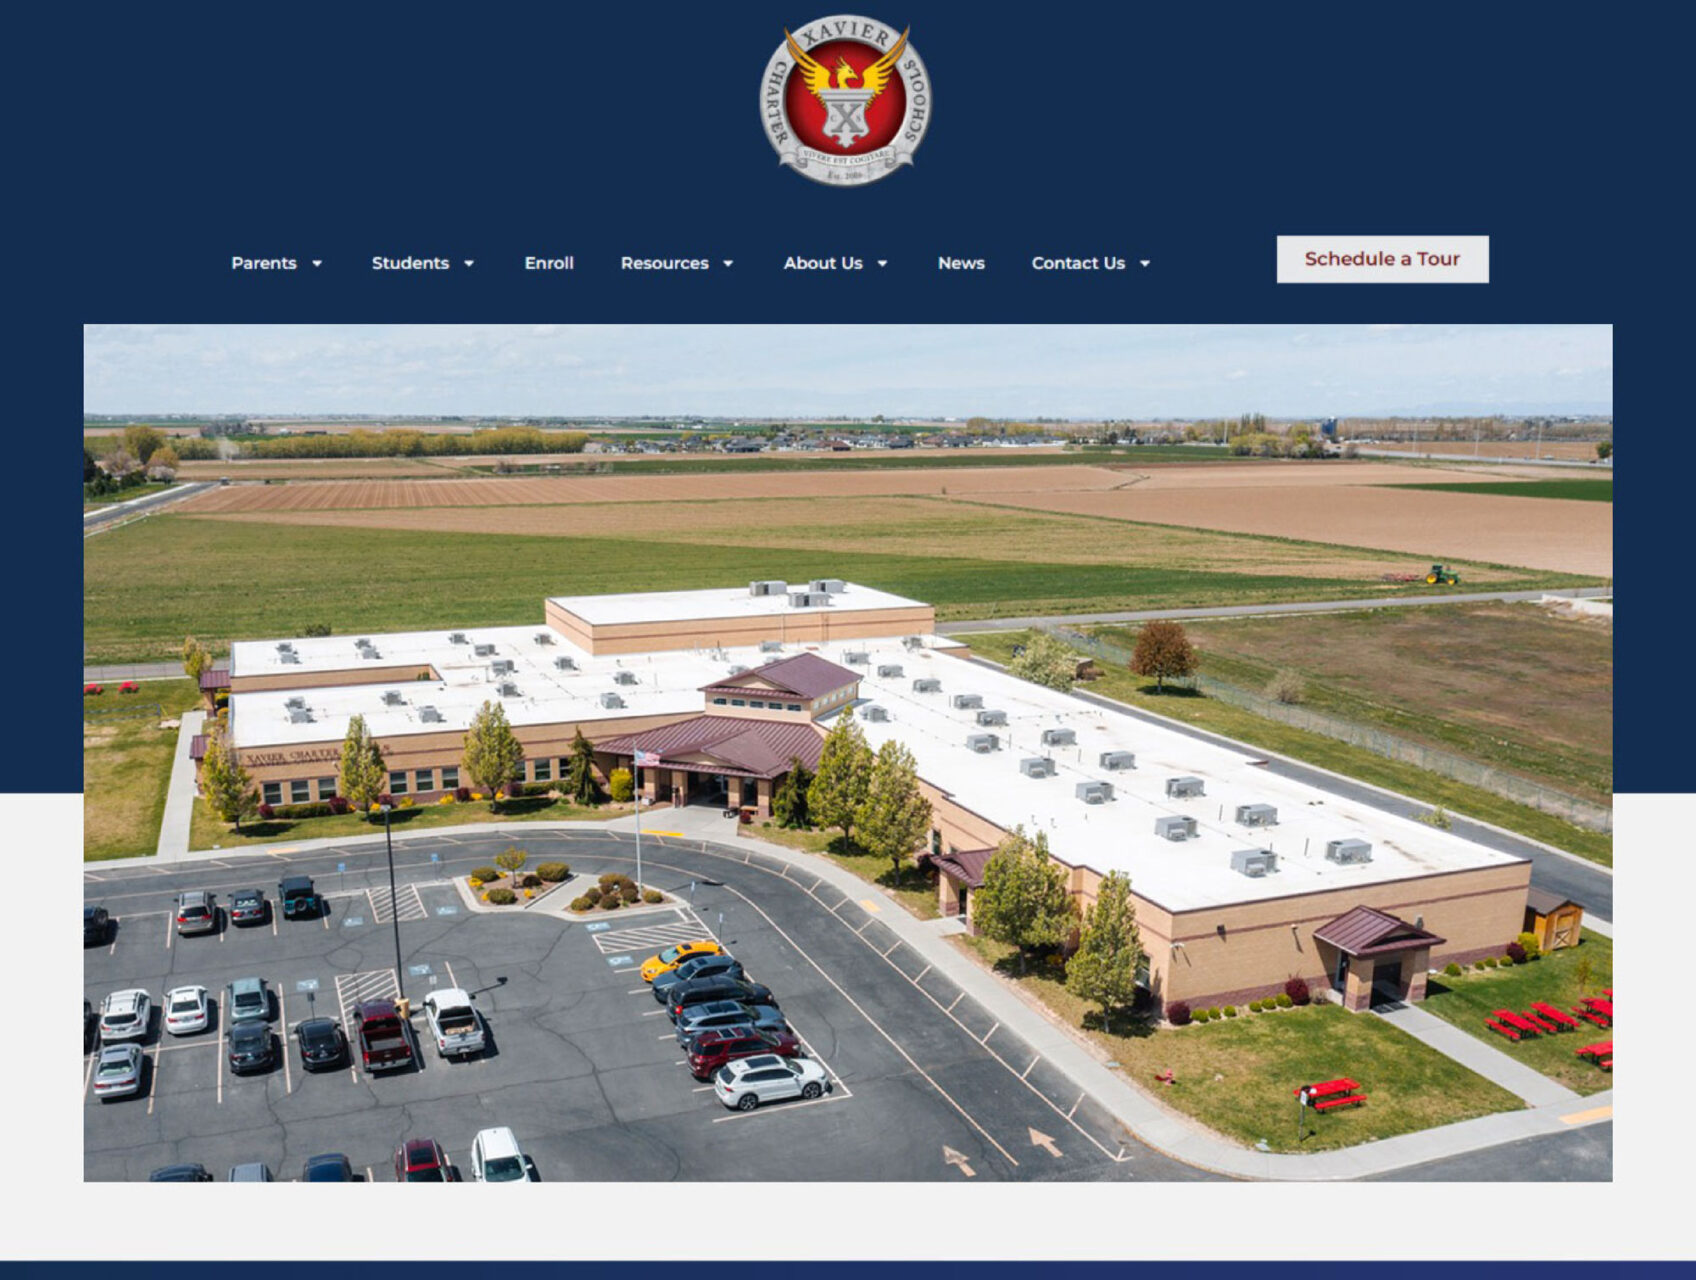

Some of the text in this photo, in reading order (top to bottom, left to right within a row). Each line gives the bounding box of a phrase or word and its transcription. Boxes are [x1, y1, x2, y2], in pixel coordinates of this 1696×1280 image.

[801, 20, 890, 47] XAVIER
[767, 61, 789, 145] CHARTER
[903, 59, 926, 142] SCHOOLS
[831, 103, 864, 133] X
[232, 256, 297, 269] Parents
[373, 256, 450, 270] Students
[525, 256, 574, 269] Enroll
[622, 257, 709, 269] Resources
[784, 256, 863, 270] About Us
[938, 257, 985, 269] News
[1032, 257, 1126, 270] Contact Us
[1306, 251, 1460, 266] Schedule a Tour
